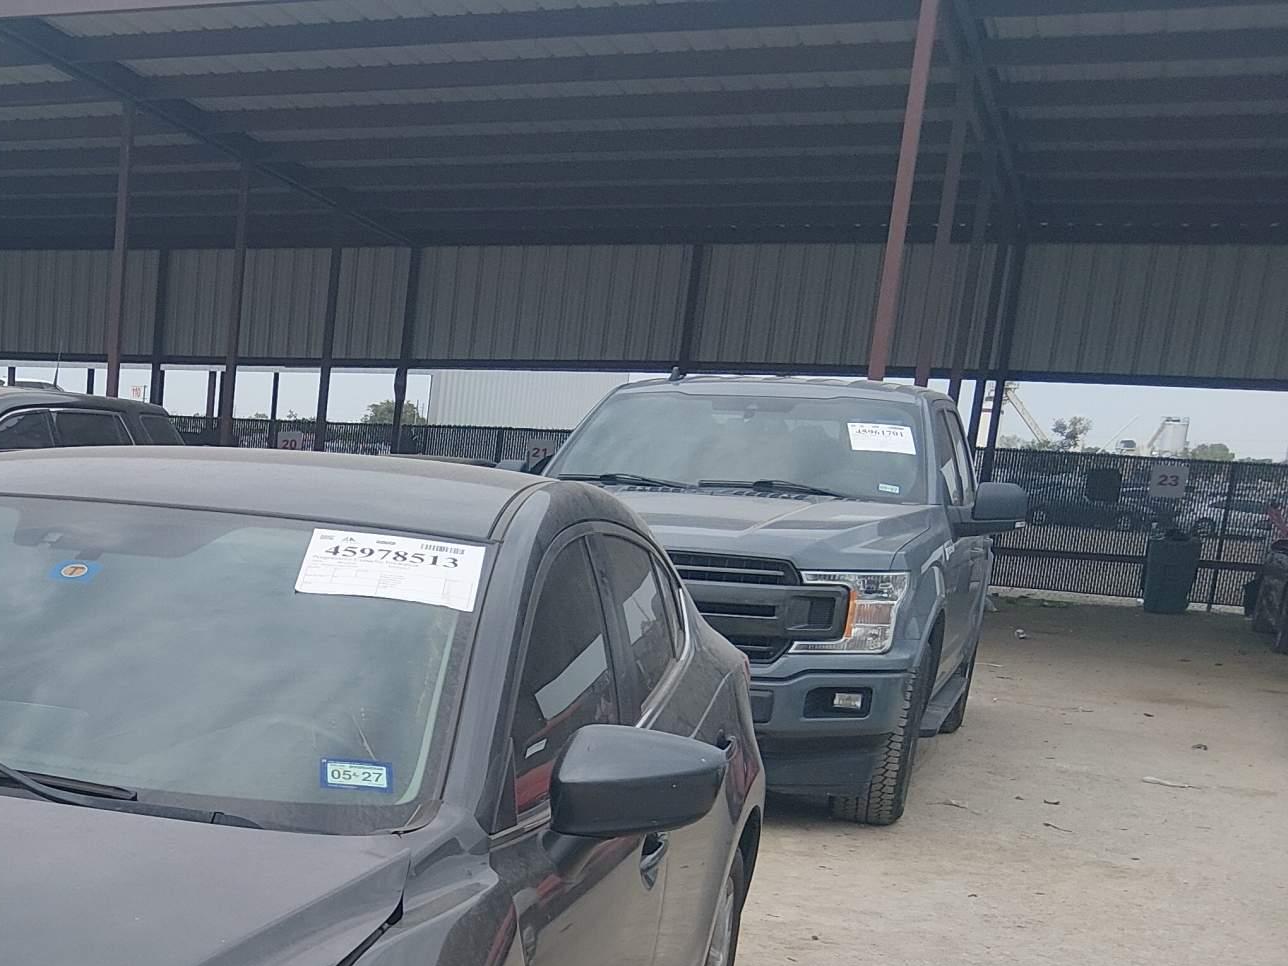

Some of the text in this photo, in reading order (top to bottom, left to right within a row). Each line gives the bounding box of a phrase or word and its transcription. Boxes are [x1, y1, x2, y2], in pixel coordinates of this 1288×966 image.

[532, 448, 547, 458] 21
[1158, 475, 1178, 486] 23
[324, 544, 459, 569] 45978513
[331, 769, 383, 783] 05-27
